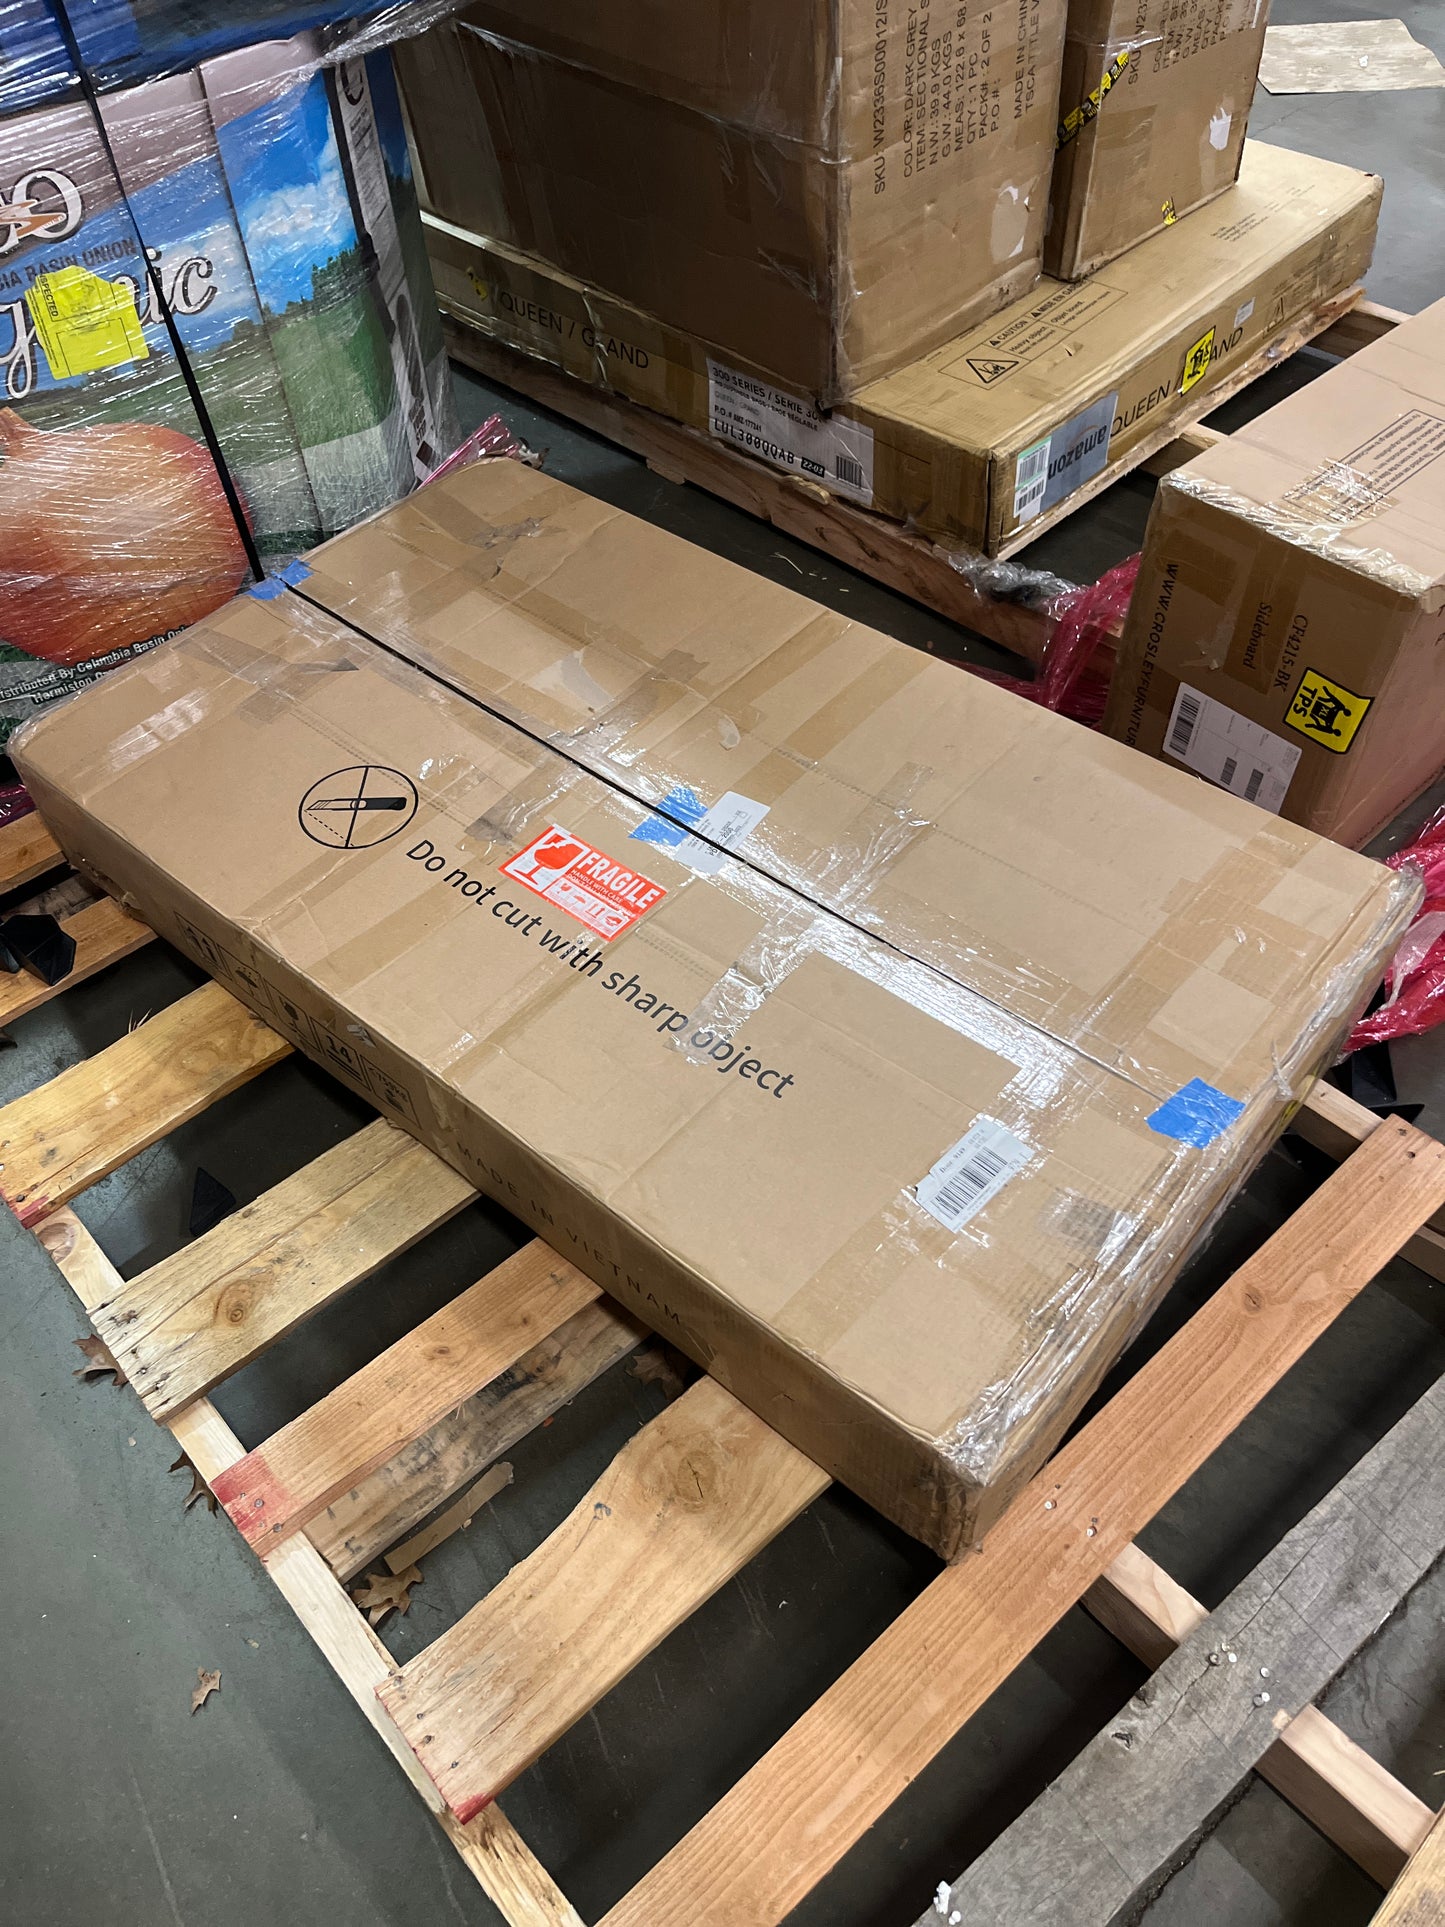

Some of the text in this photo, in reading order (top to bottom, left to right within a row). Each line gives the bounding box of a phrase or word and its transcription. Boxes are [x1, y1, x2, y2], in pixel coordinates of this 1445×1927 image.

[907, 8, 917, 56] GREY
[983, 11, 992, 24] 2
[931, 38, 942, 80] KGS
[943, 30, 953, 71] KGS
[981, 28, 991, 53] OF
[981, 53, 990, 68] 2
[1016, 49, 1025, 64] IN
[917, 14, 930, 120] SECTIONAL
[969, 52, 978, 82] PC
[1026, 64, 1036, 111] TSCA
[905, 65, 915, 112] DARK
[930, 81, 941, 119] 39.9
[943, 73, 953, 113] 44.0
[1014, 66, 1025, 120] MADE
[500, 290, 564, 335] QUEEN
[581, 326, 650, 370] GAND
[996, 319, 1029, 342] CAUTION
[713, 368, 731, 382] 300
[731, 375, 767, 399] SERIES
[1110, 379, 1171, 436] QUEEN
[1047, 424, 1108, 482] amazon
[1242, 601, 1273, 672] Sideboard
[1272, 613, 1309, 696] CF4215-BK
[1292, 685, 1318, 718] TPS
[1318, 705, 1330, 717] XL
[570, 868, 595, 887] HANDLE
[593, 881, 610, 897] WITH
[606, 890, 624, 905] CARE
[577, 851, 661, 911] FRAGILE
[406, 838, 446, 872] Do
[442, 865, 498, 907] not
[490, 898, 543, 938] cut
[538, 929, 605, 979] with
[601, 969, 691, 1036] sharp
[689, 1022, 798, 1100] object
[325, 1034, 354, 1066] 14
[456, 1140, 683, 1326] MADE IN VIETNAM
